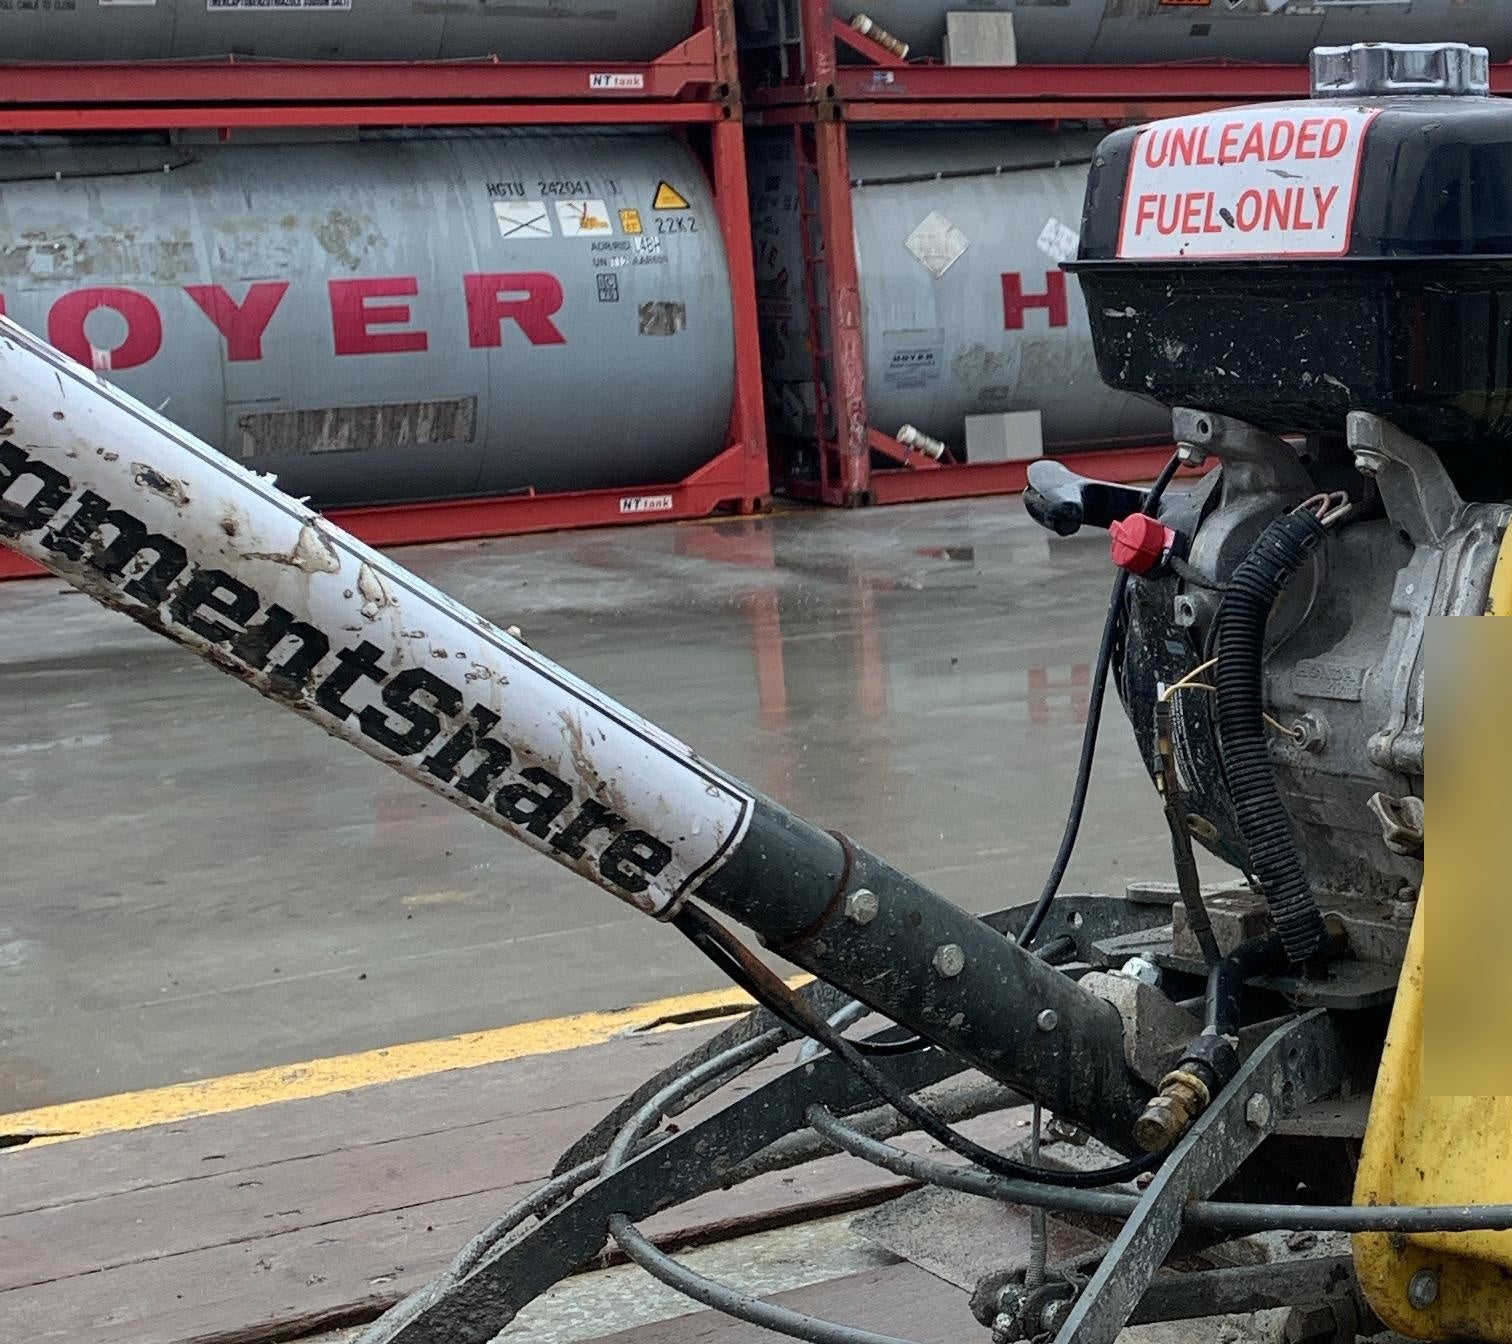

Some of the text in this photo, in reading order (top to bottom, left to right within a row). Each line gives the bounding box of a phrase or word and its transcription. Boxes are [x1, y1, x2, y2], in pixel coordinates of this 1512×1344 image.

[614, 75, 641, 86] tank
[1143, 117, 1348, 170] UNLEADED
[485, 182, 526, 197] HGTU
[537, 181, 593, 196] 242041
[1133, 185, 1339, 236] FUEL ONLY
[654, 215, 700, 235] 22K2
[0, 272, 566, 370] OYER
[643, 496, 670, 508] tank
